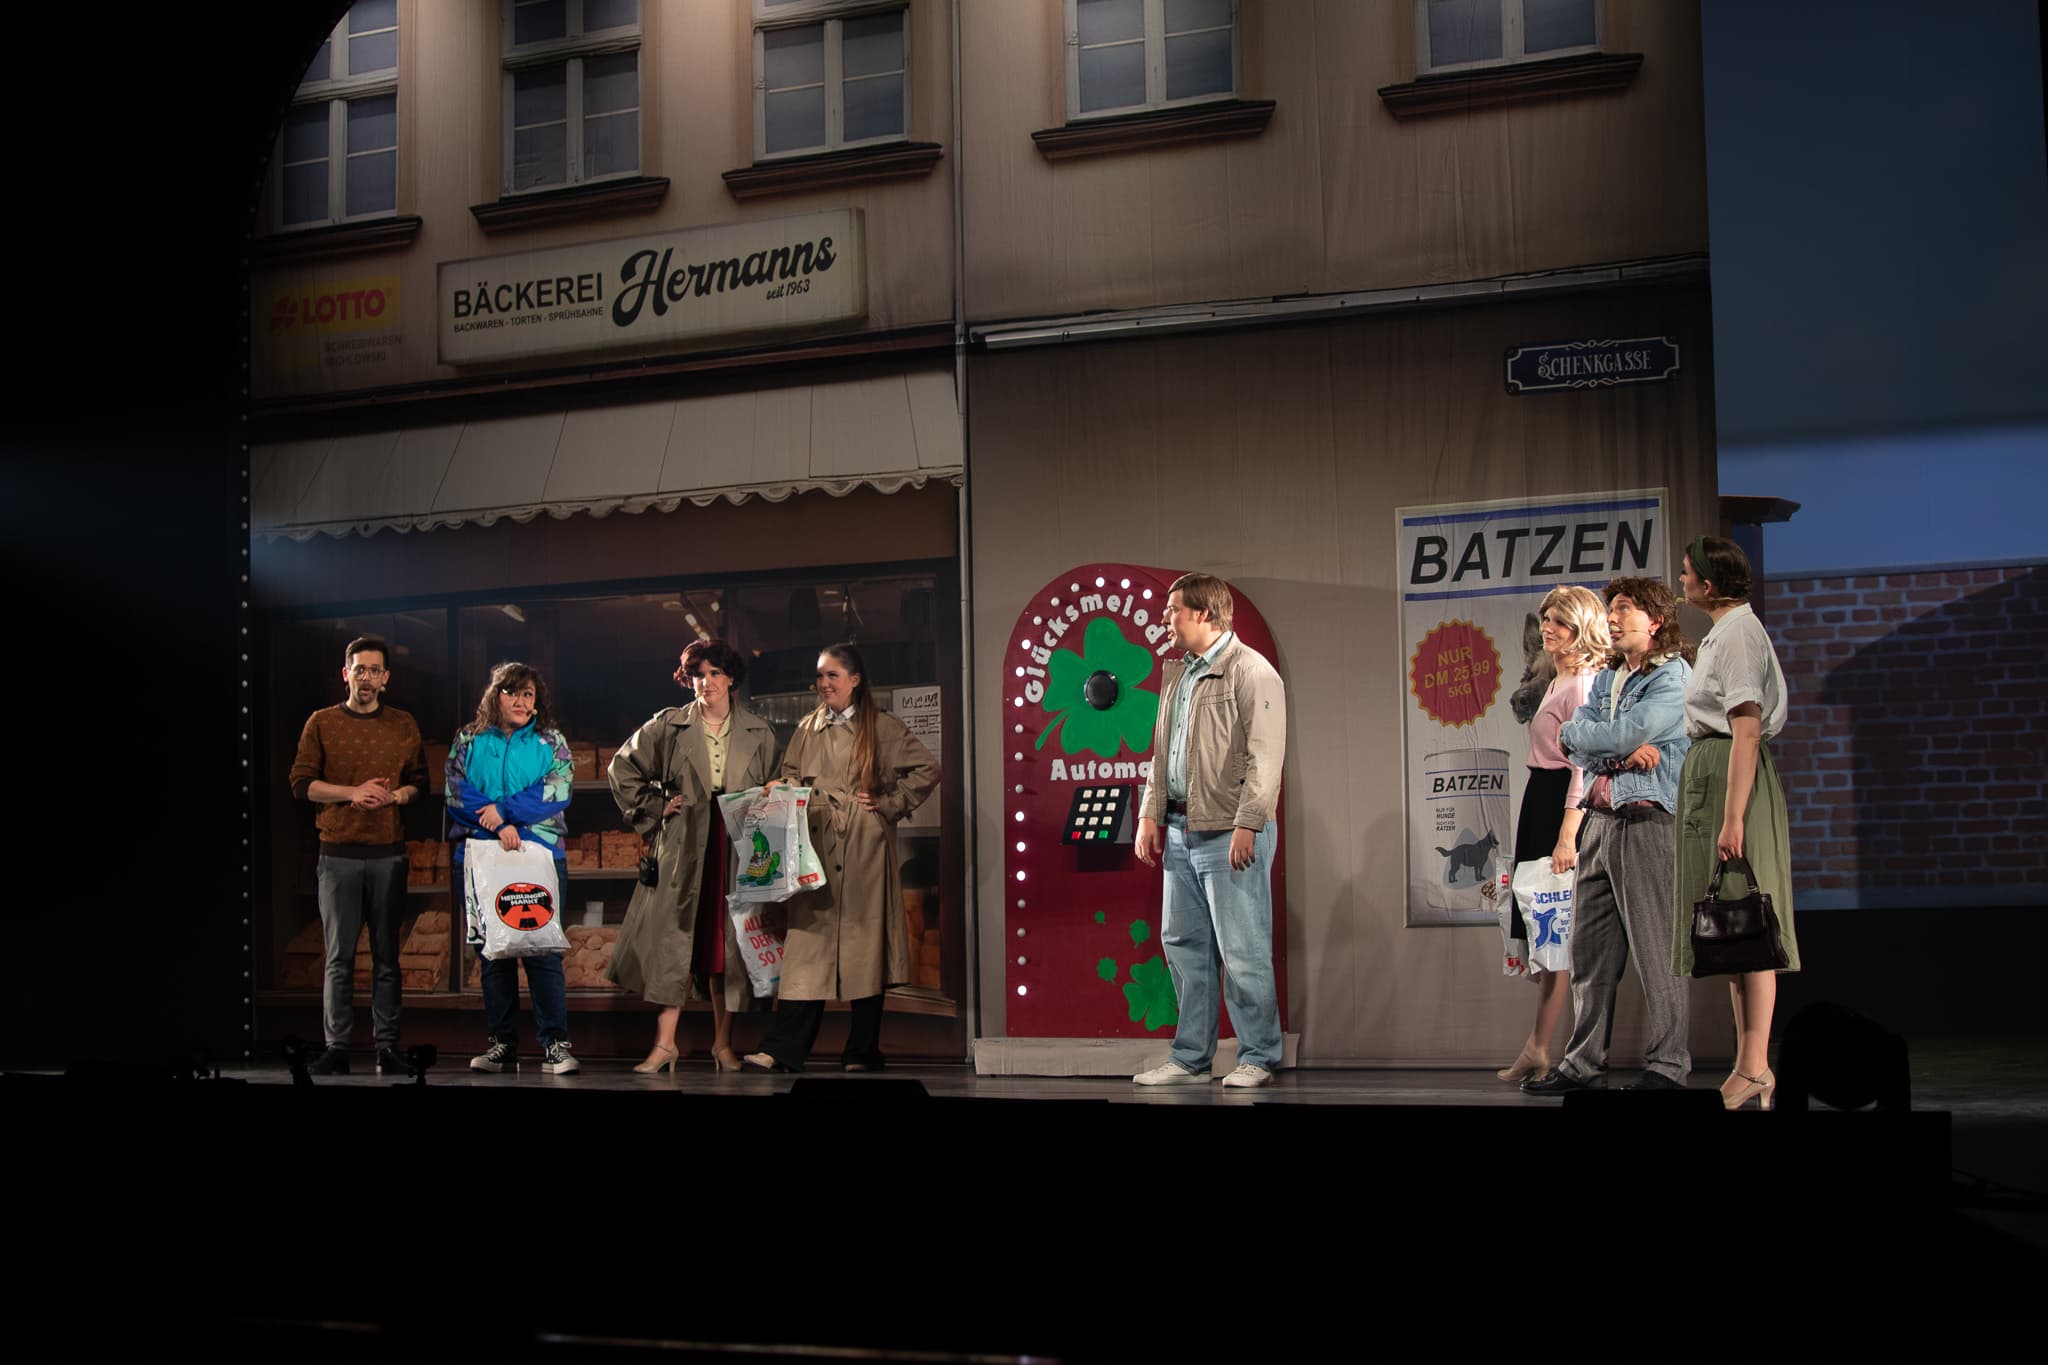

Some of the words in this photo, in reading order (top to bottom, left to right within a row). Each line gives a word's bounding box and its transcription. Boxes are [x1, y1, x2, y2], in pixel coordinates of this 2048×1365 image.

[612, 237, 837, 327] Hermanns
[766, 283, 785, 301] seit
[785, 278, 811, 297] 1963
[303, 288, 386, 324] LOTTO
[453, 272, 603, 318] BÄCKEREI
[453, 318, 505, 333] BACKWAREN
[510, 313, 543, 327] TORTEN
[548, 306, 604, 323] SPRÜHSAHNE
[1410, 519, 1653, 585] BATZEN
[1025, 593, 1173, 703] Glücksmelodi
[1437, 646, 1472, 667] NUR
[1424, 669, 1449, 689] DM
[1453, 659, 1490, 682] 25.99
[1448, 683, 1472, 698] 5KG
[1050, 759, 1153, 781] Automa
[1432, 774, 1504, 794] BATZEN
[510, 898, 538, 906] MARKT
[749, 932, 774, 950] DER
[758, 950, 777, 967] SO
